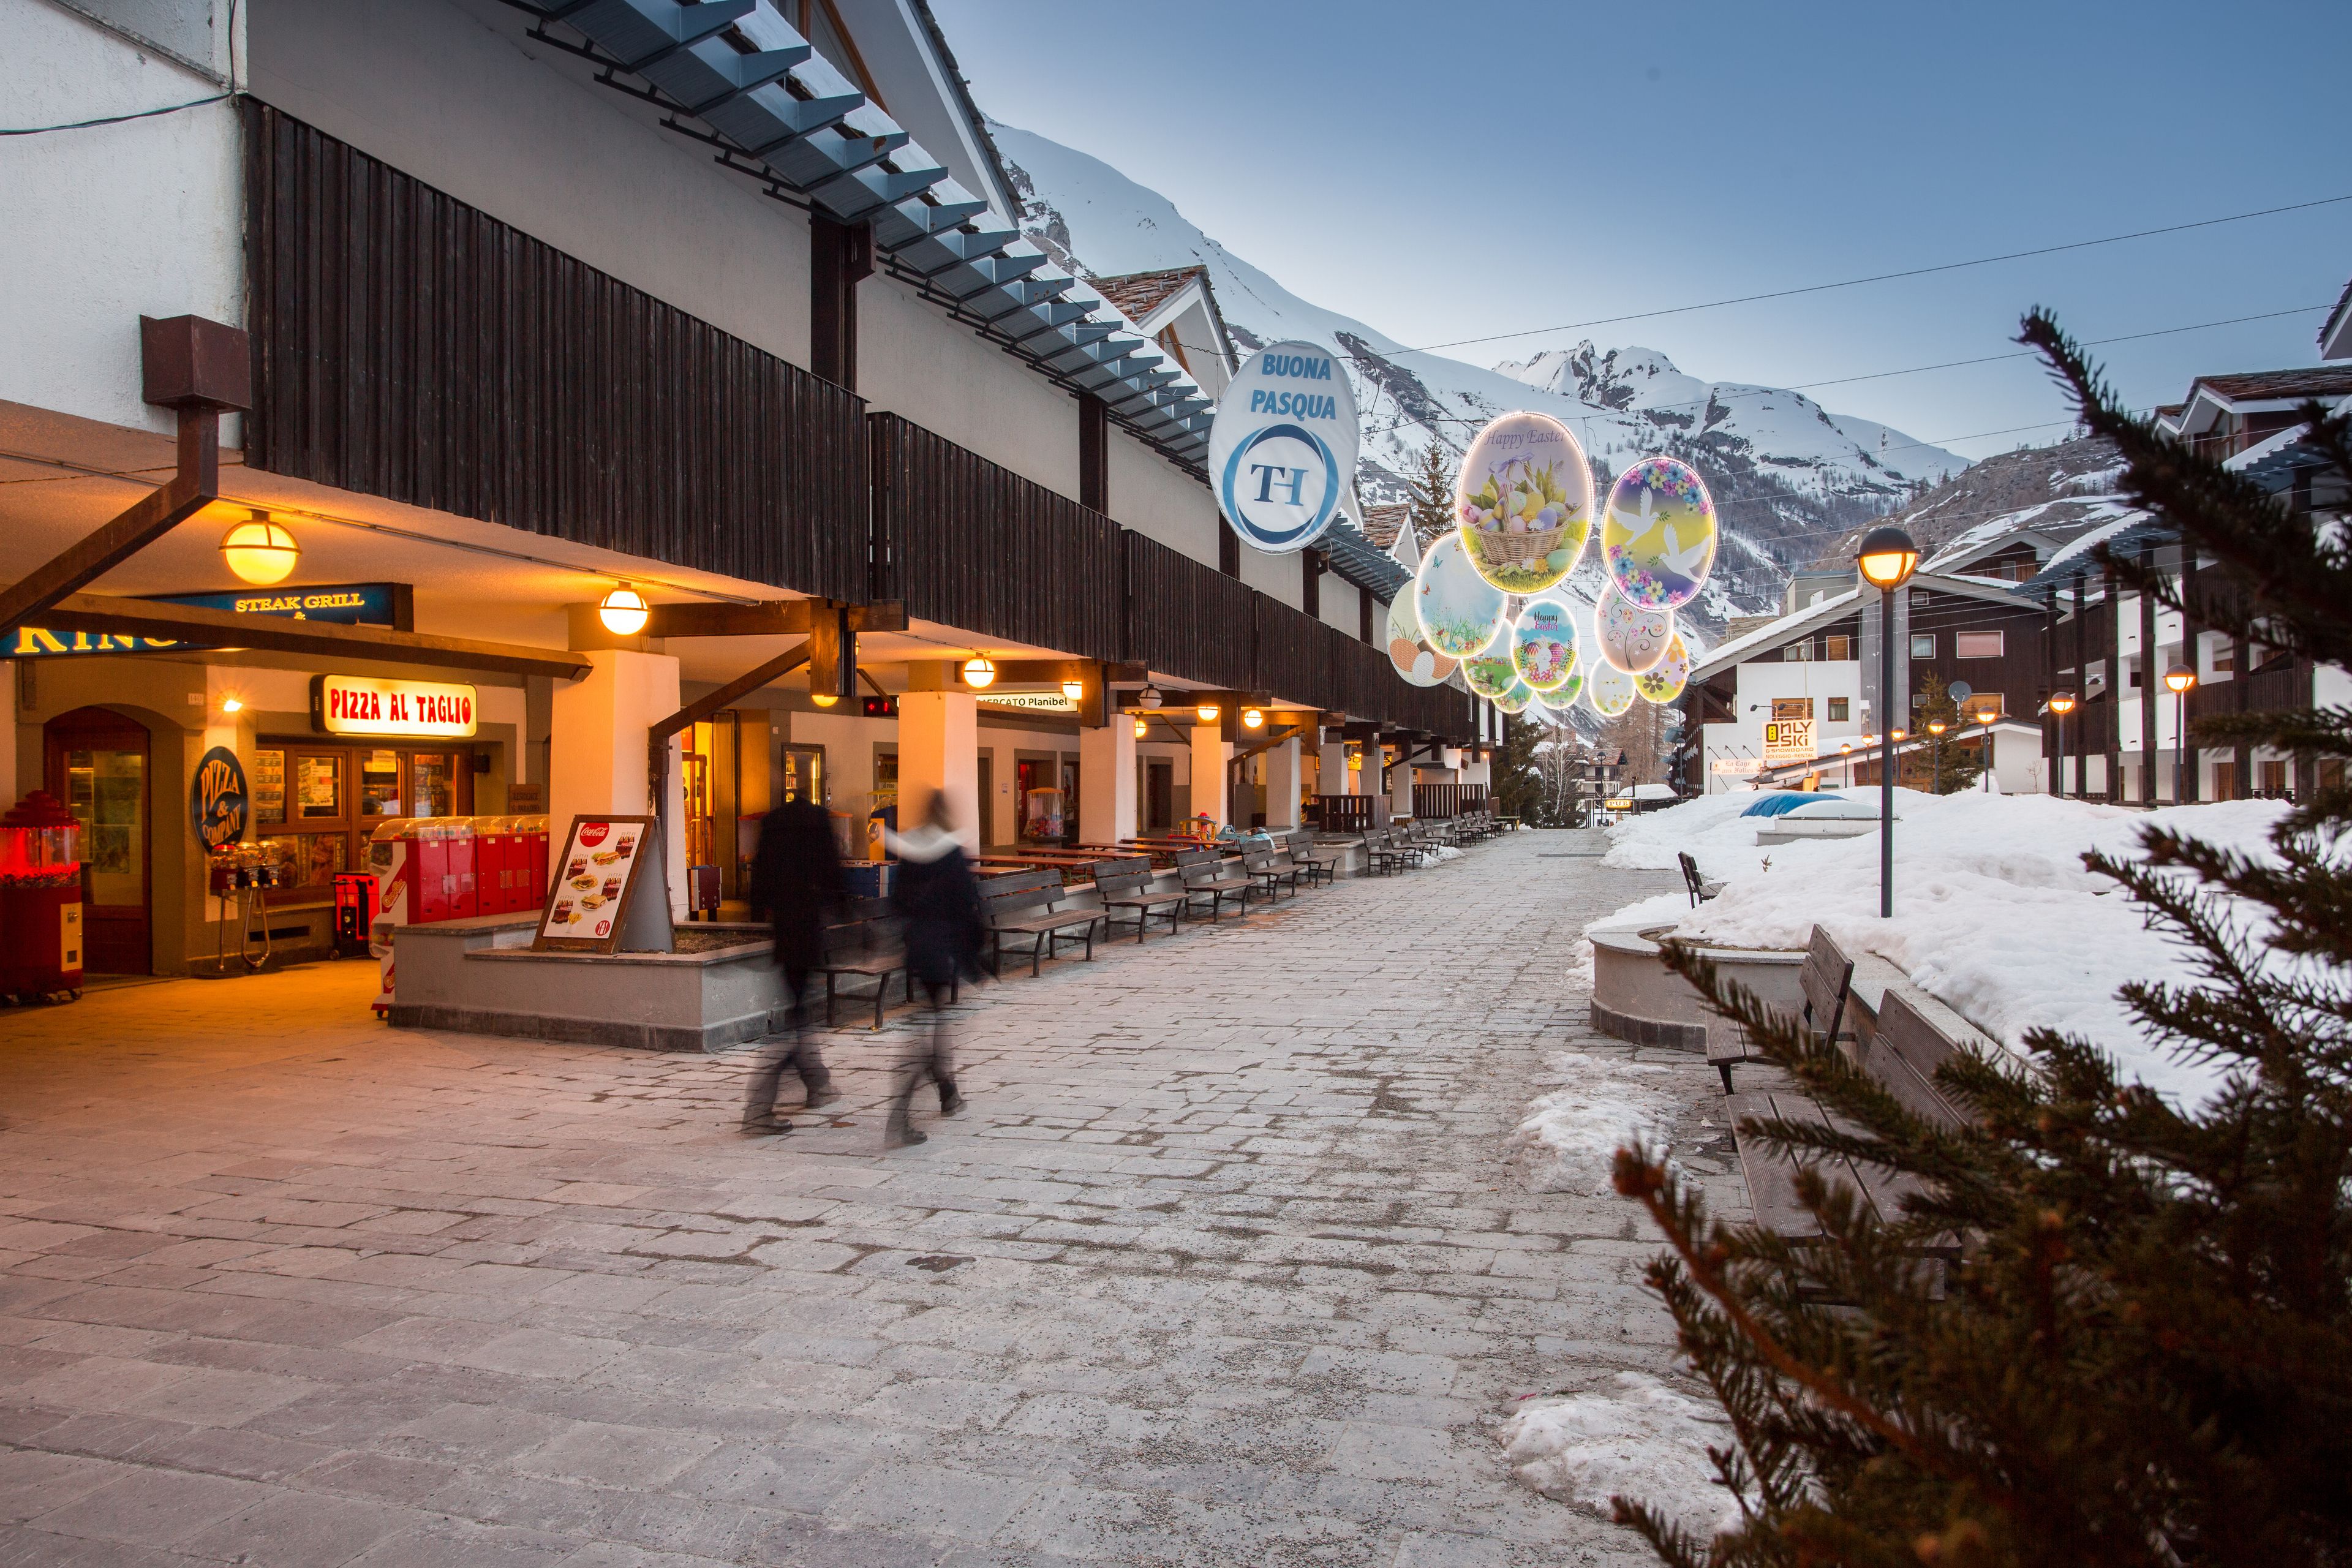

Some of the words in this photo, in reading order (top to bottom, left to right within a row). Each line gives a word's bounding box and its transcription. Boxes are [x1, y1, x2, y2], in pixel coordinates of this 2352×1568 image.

[1261, 353, 1331, 380] BUONA
[1250, 390, 1336, 422] PASQUA
[1484, 430, 1524, 450] Happy
[1250, 464, 1309, 506] TH
[235, 597, 301, 612] STEAK
[304, 593, 365, 609] GRILL
[1534, 611, 1558, 624] Happy
[1534, 620, 1558, 631] Easter
[331, 688, 381, 720] PIZZA
[390, 692, 408, 721] AL
[416, 695, 471, 725] TAGLIO
[1028, 697, 1068, 706] Planibel
[201, 760, 240, 824] PIZZA
[217, 801, 229, 817] &
[202, 804, 241, 845] COMPANY
[581, 827, 608, 837] Coca-Cola
